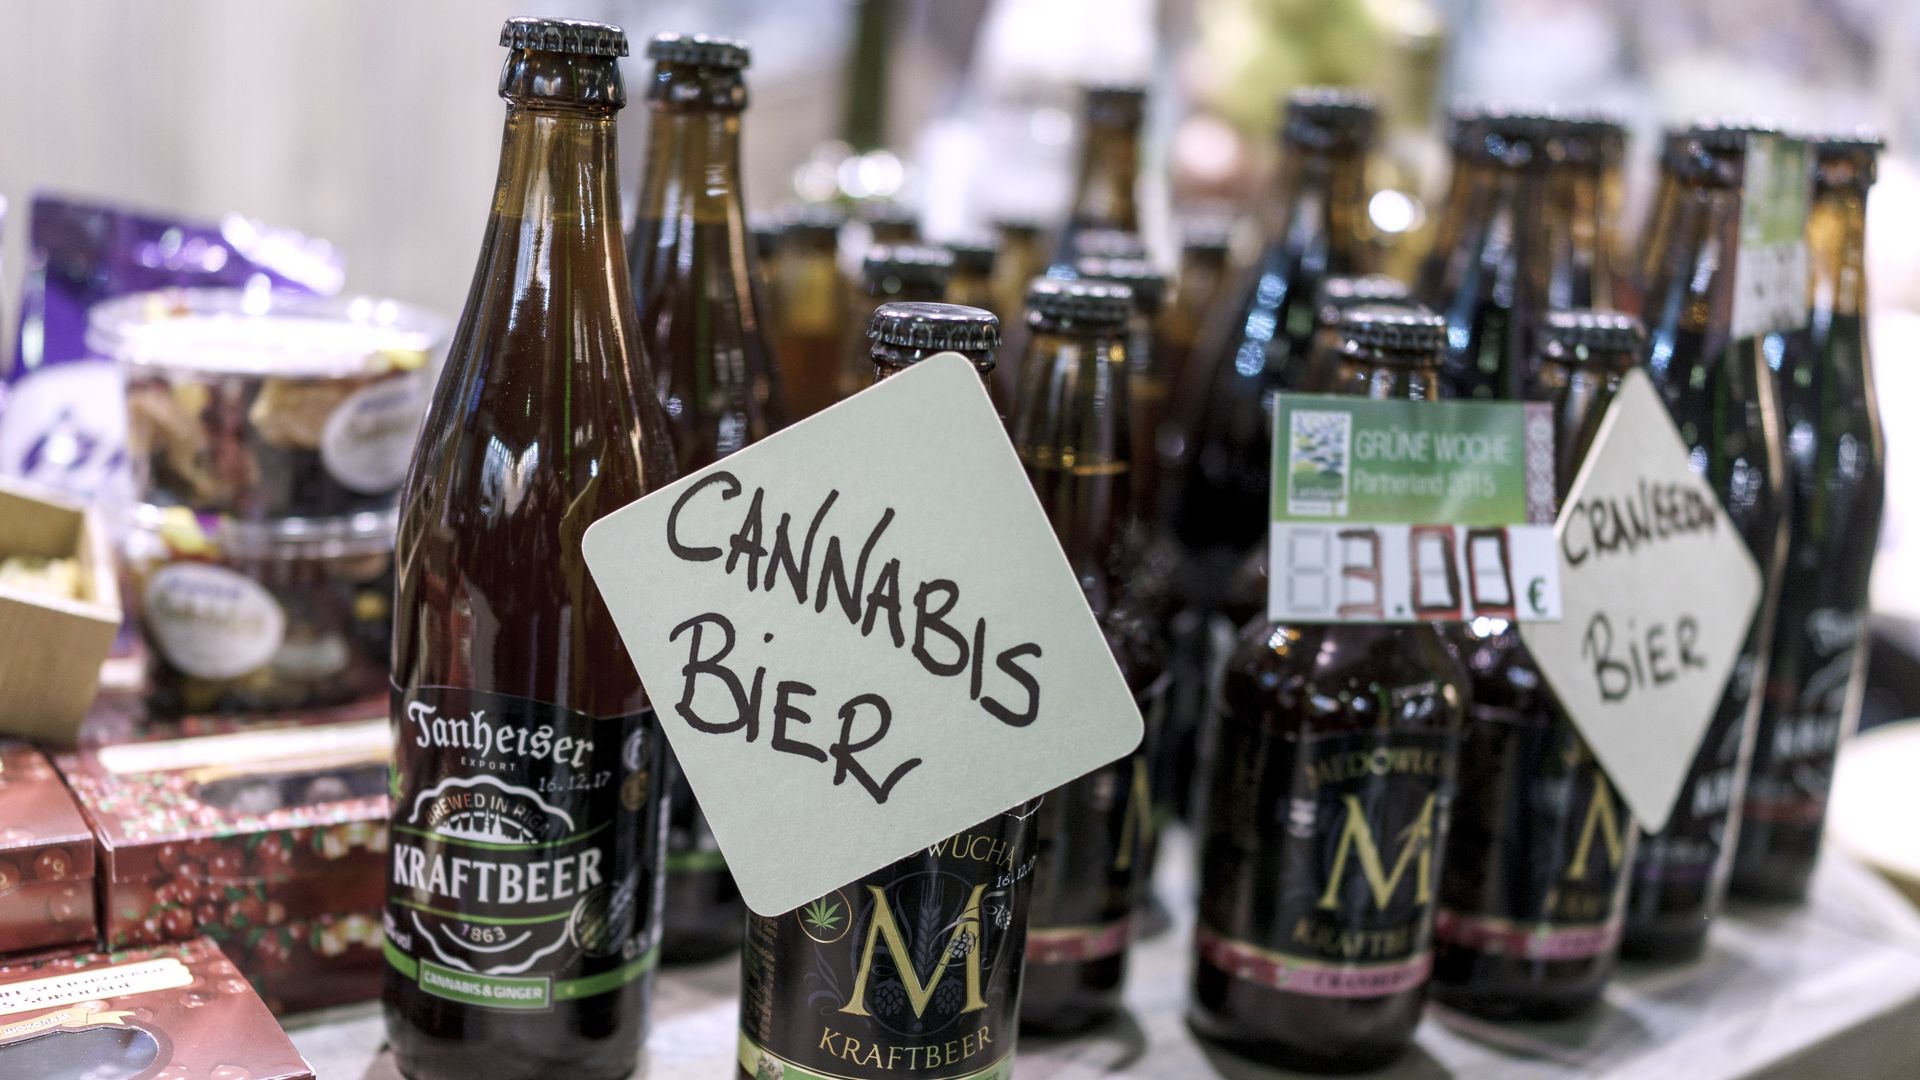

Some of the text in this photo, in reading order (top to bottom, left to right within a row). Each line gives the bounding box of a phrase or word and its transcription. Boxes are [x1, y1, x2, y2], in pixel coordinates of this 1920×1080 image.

[1356, 424, 1430, 463] GRÜNE
[667, 471, 1042, 728] CANNABIS
[407, 700, 595, 768] Tanheiser
[460, 756, 516, 772] EXPORT
[425, 792, 486, 827] BREWED
[489, 795, 509, 814] IN
[909, 833, 1015, 872] WUCHA
[1318, 792, 1437, 911] M
[393, 844, 604, 905] KRAFTBEER
[461, 923, 507, 943] 1863
[838, 883, 988, 1019] M
[424, 969, 544, 1000] CANNABIS & GINGER
[819, 1025, 993, 1071] KRAFTBEER
